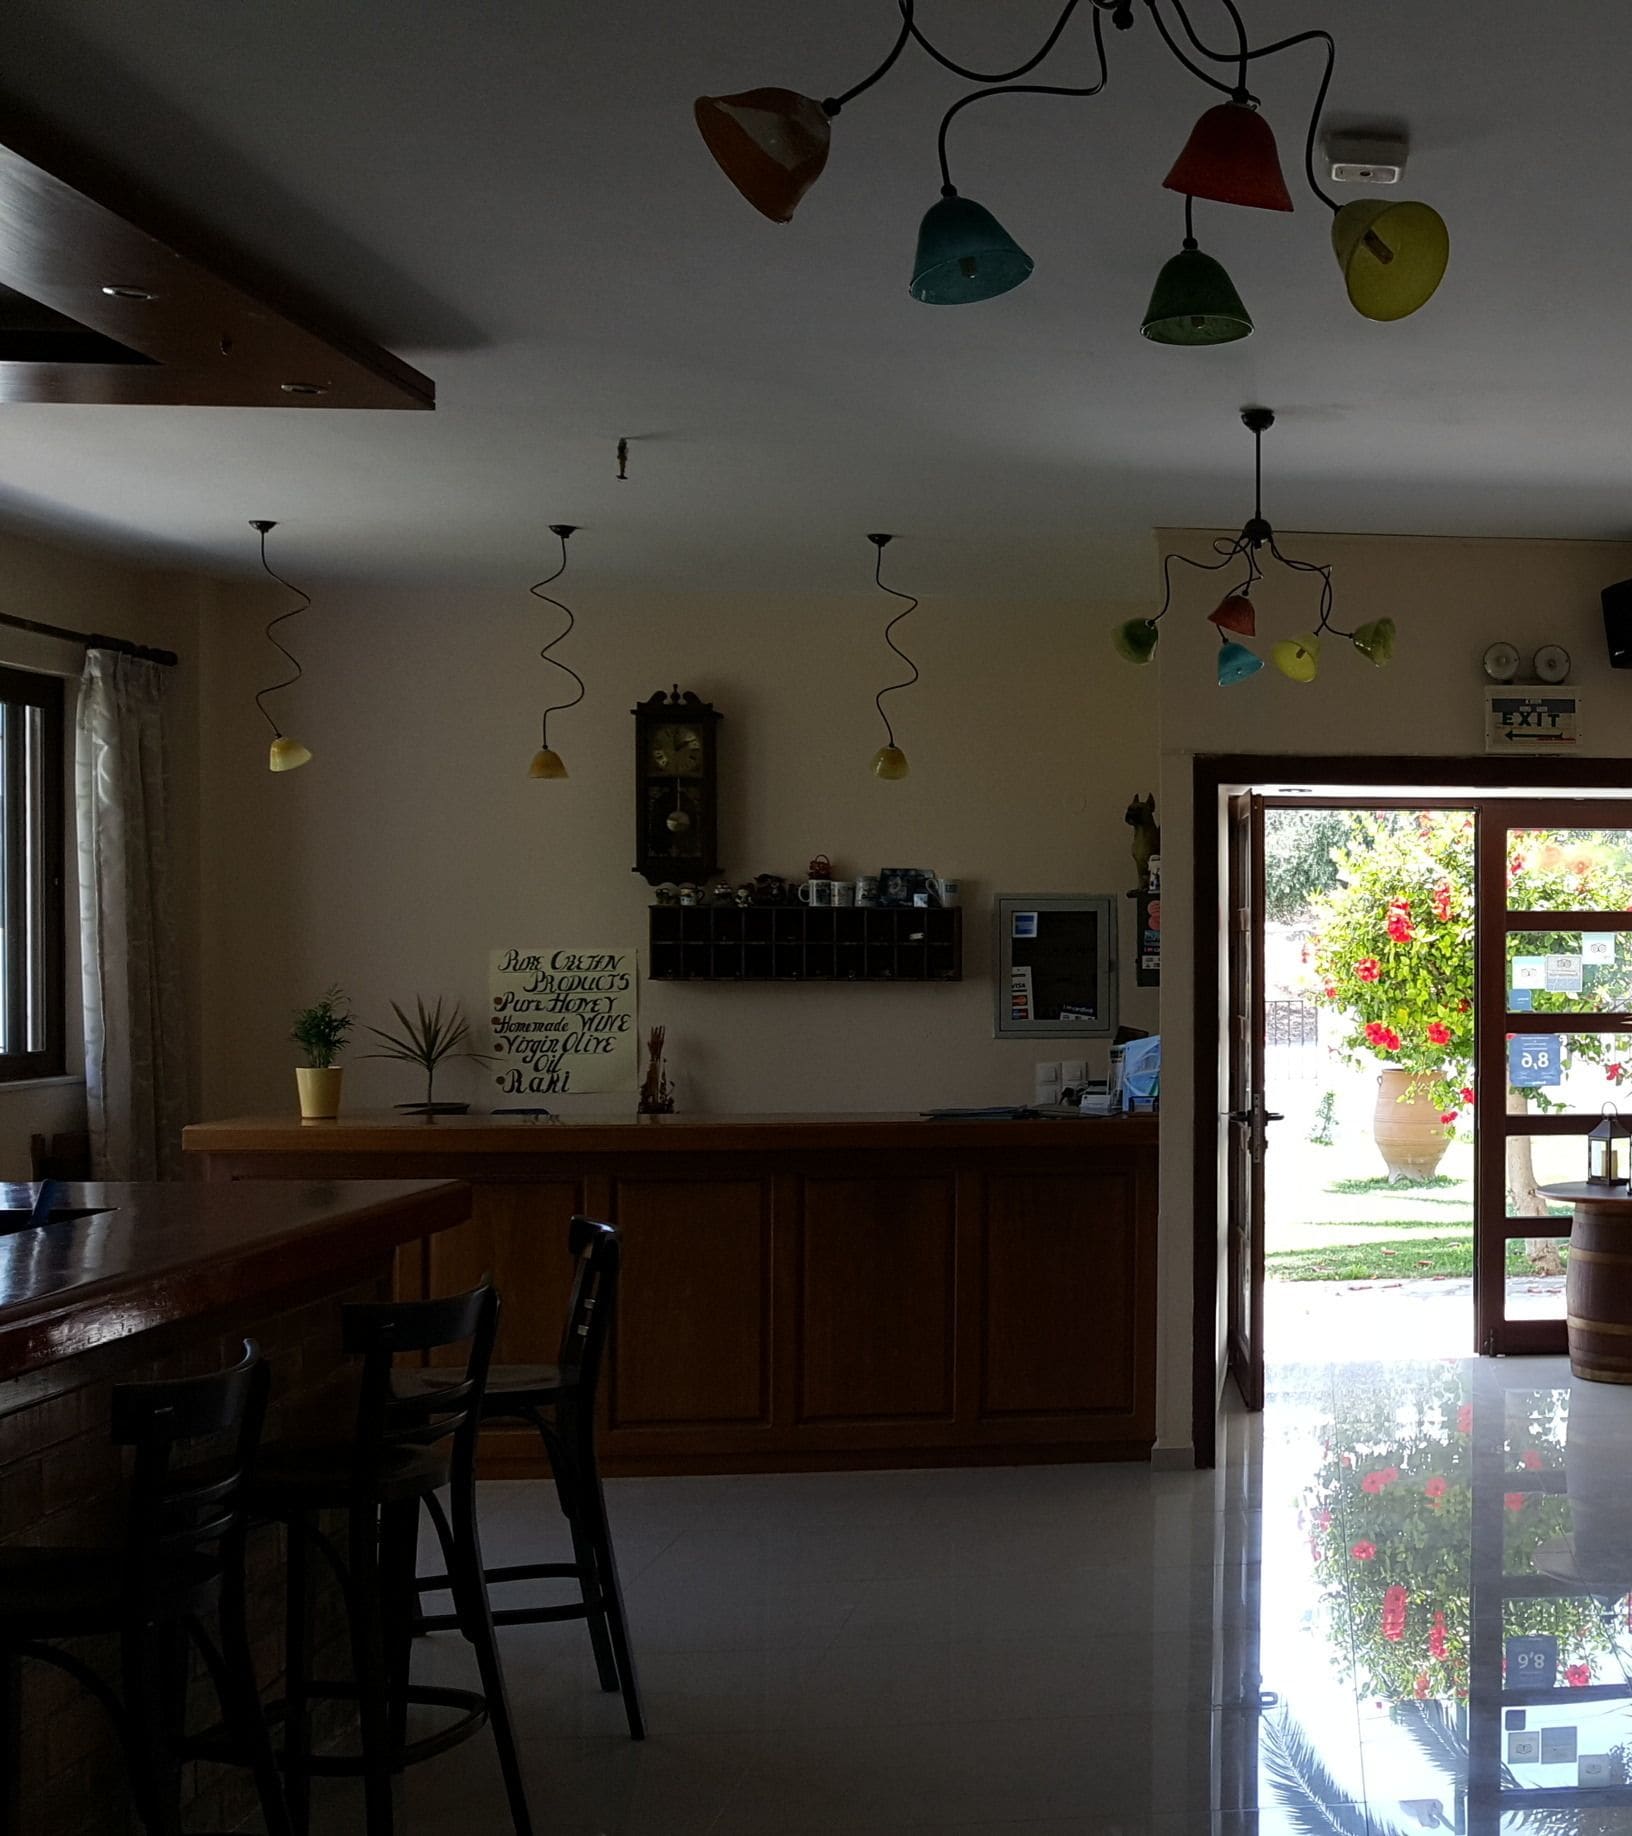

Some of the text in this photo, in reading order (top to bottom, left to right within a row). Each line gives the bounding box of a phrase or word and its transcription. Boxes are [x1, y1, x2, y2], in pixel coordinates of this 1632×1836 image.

[1502, 711, 1560, 727] EXIT
[523, 971, 632, 993] PRODUCTS
[546, 992, 618, 1014] HONEY
[494, 1013, 632, 1034] Homemade WINE
[500, 1035, 559, 1064] Virgin
[533, 1053, 563, 1074] Oil
